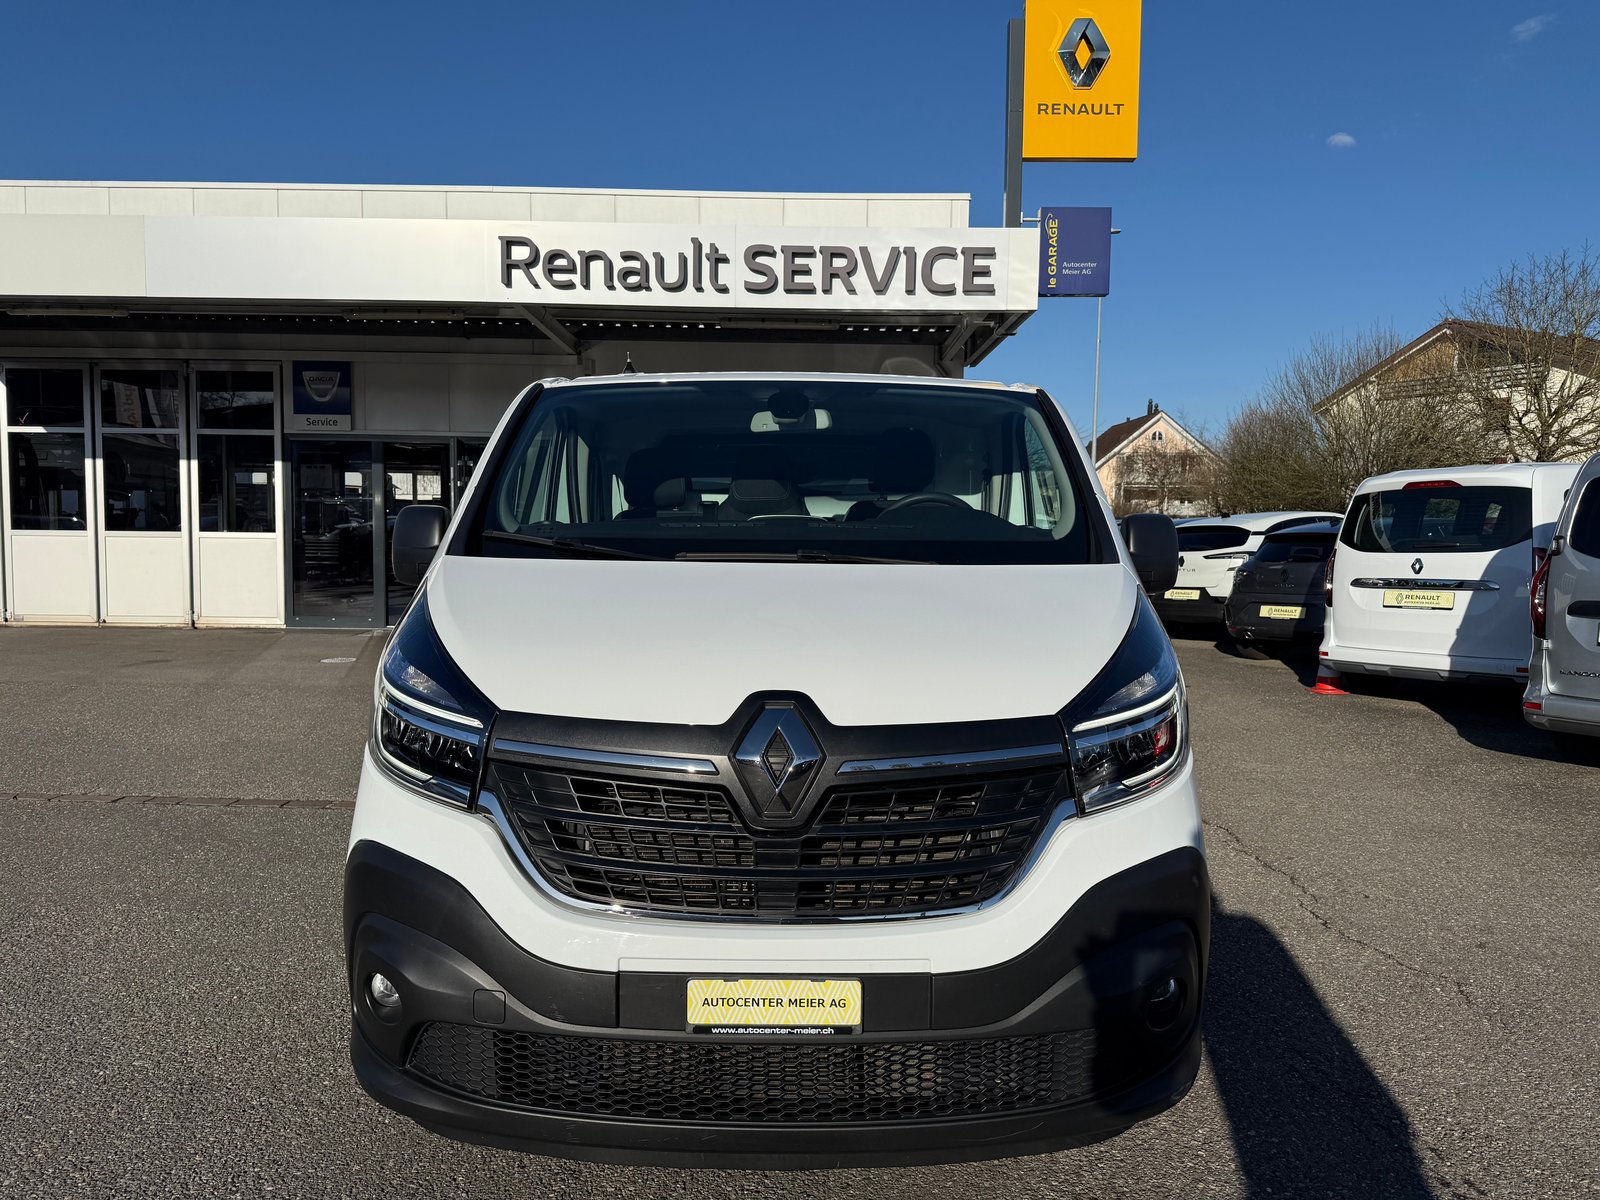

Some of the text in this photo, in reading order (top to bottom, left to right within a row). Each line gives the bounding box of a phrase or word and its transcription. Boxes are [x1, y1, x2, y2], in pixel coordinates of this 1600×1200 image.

[1037, 103, 1125, 116] RENAULT
[1047, 218, 1059, 288] le GARAGE
[498, 235, 997, 297] Renault SERVICE
[306, 417, 339, 427] Service
[702, 997, 847, 1009] AUTOCENTER MEIER AG
[711, 1026, 835, 1035] www.autocenter-meier.ch
